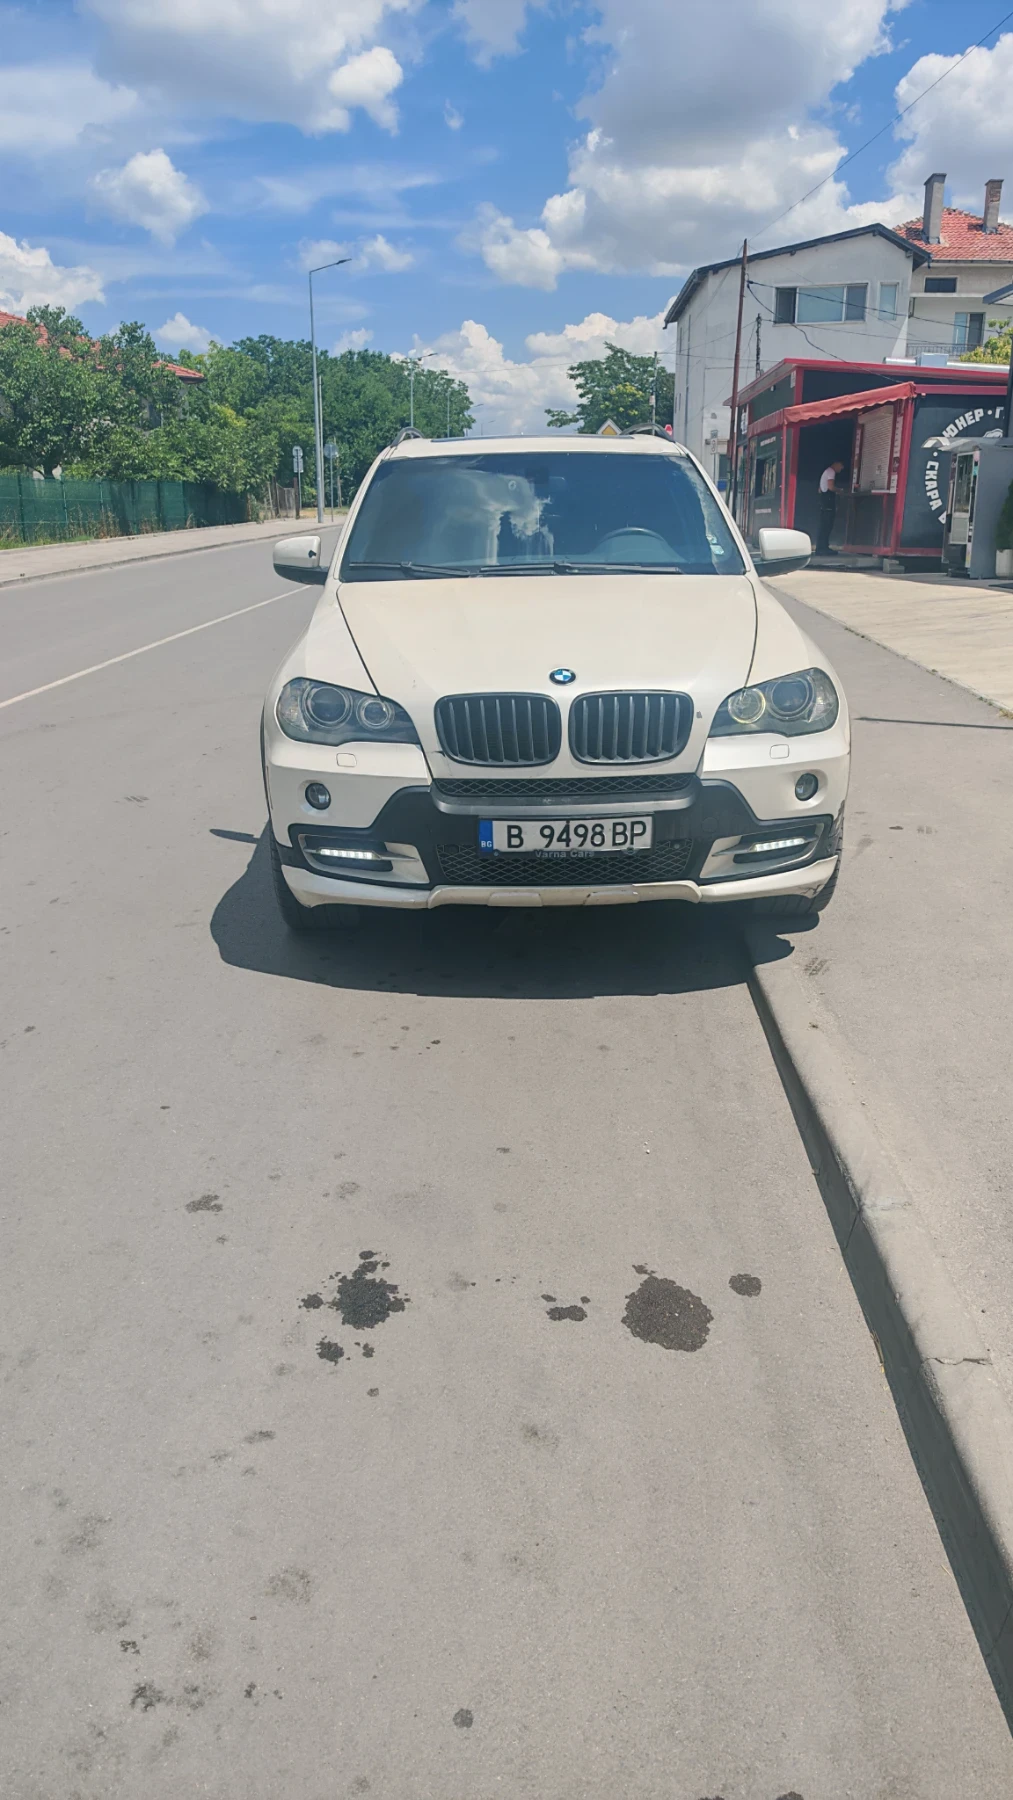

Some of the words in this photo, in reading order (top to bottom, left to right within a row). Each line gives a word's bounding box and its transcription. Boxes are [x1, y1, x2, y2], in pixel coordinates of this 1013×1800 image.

[941, 408, 984, 438] ЮНЕР
[925, 460, 943, 511] СКАРА
[480, 840, 493, 848] BG
[507, 824, 524, 849] B
[539, 823, 605, 849] 9498
[611, 820, 647, 847] BP
[534, 849, 567, 858] Varna
[570, 849, 595, 858] Cars
